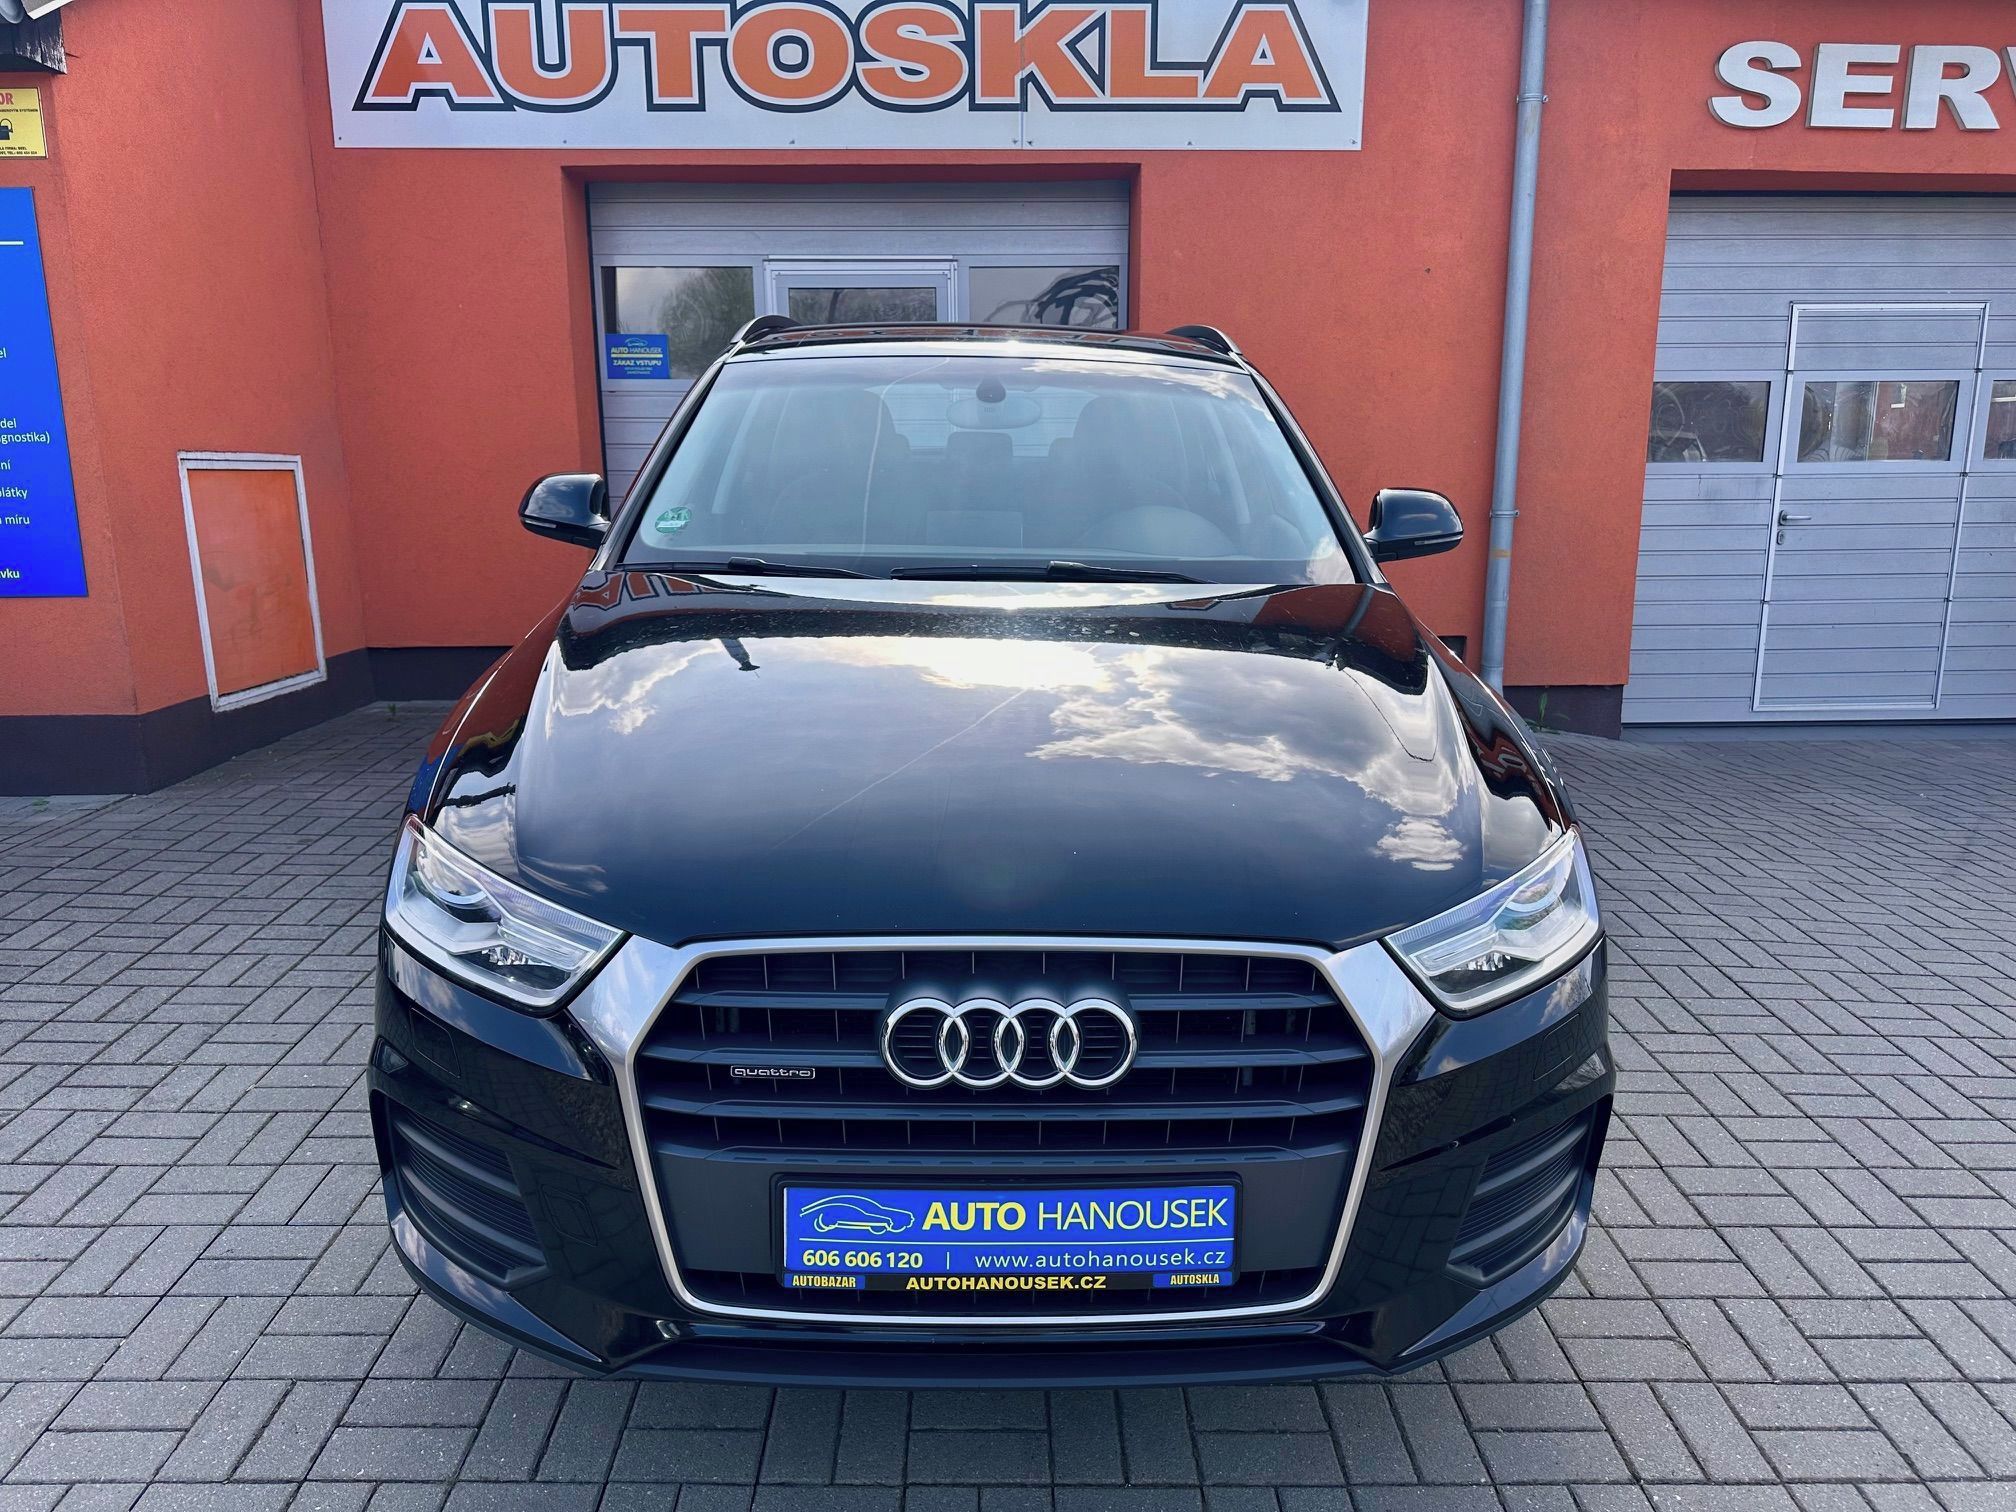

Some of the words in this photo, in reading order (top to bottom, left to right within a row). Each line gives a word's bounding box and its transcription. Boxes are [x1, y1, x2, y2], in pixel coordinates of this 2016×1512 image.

[351, 0, 1342, 113] AUTOSKLA
[1707, 40, 2016, 131] SER
[0, 431, 50, 445] gnostika)
[5, 514, 30, 525] míru
[734, 1068, 811, 1077] quattro
[922, 1201, 1027, 1231] AUTO
[1038, 1198, 1228, 1231] HANOUSEK
[802, 1249, 840, 1267] 606
[844, 1250, 882, 1268] 606
[886, 1251, 924, 1269] 120
[974, 1248, 1226, 1268] www.autohanousek.cz
[792, 1275, 856, 1288] AUTOBAZAR
[905, 1276, 1107, 1290] AUTOHANOUSEK.CZ
[1170, 1273, 1220, 1285] AUTOSKLA
